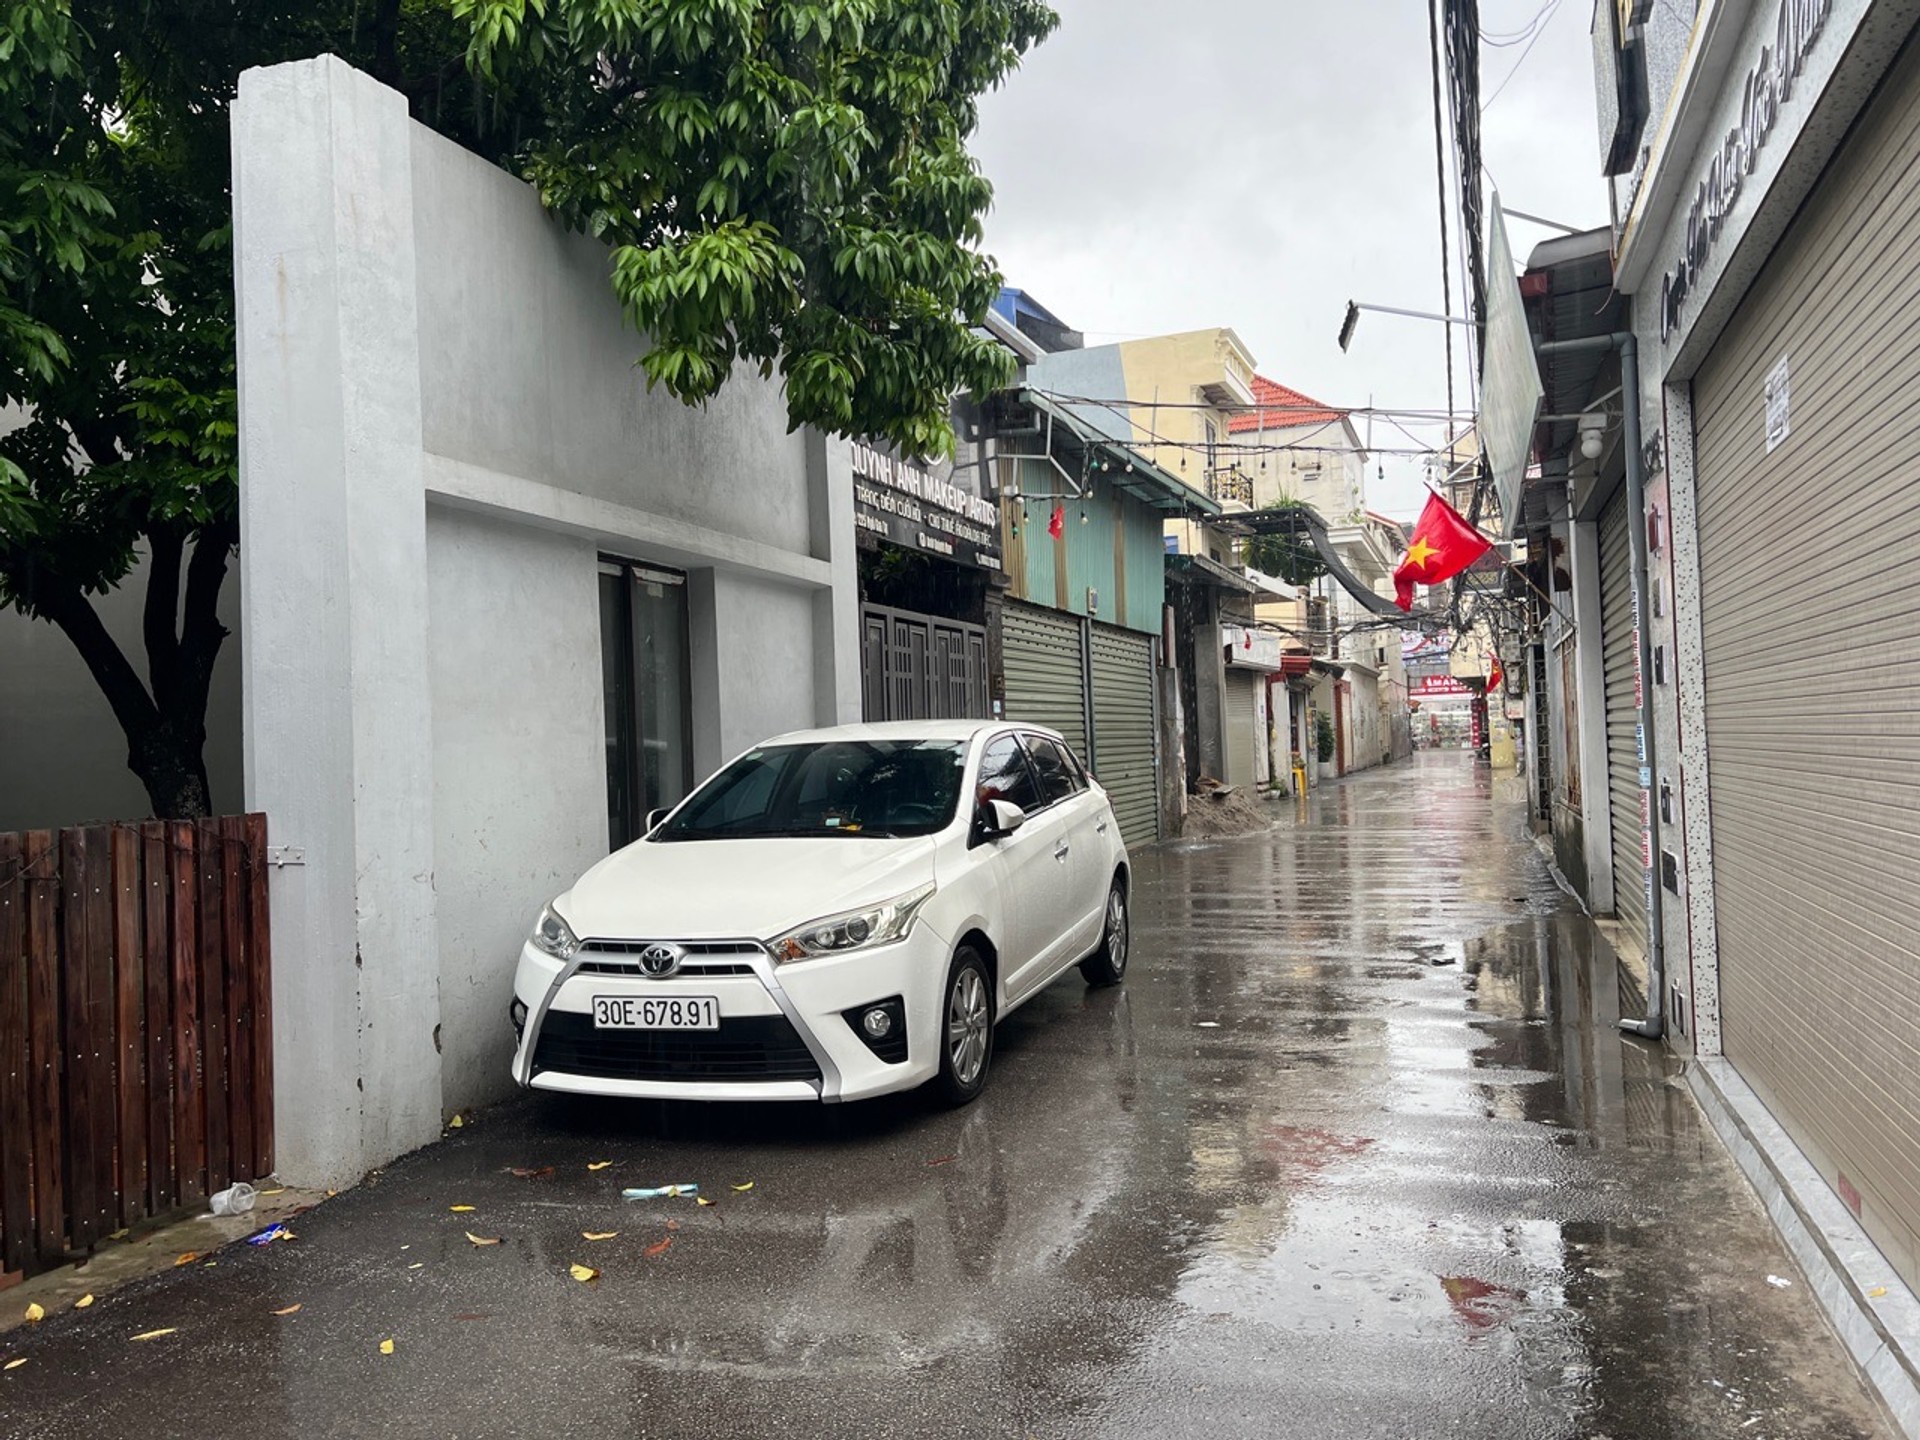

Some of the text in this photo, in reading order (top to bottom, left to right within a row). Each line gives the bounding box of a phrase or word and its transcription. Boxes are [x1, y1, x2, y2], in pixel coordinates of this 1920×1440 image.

[897, 462, 921, 498] ANH
[923, 473, 965, 515] MAKEUP
[597, 1000, 711, 1026] 30E-678.91
